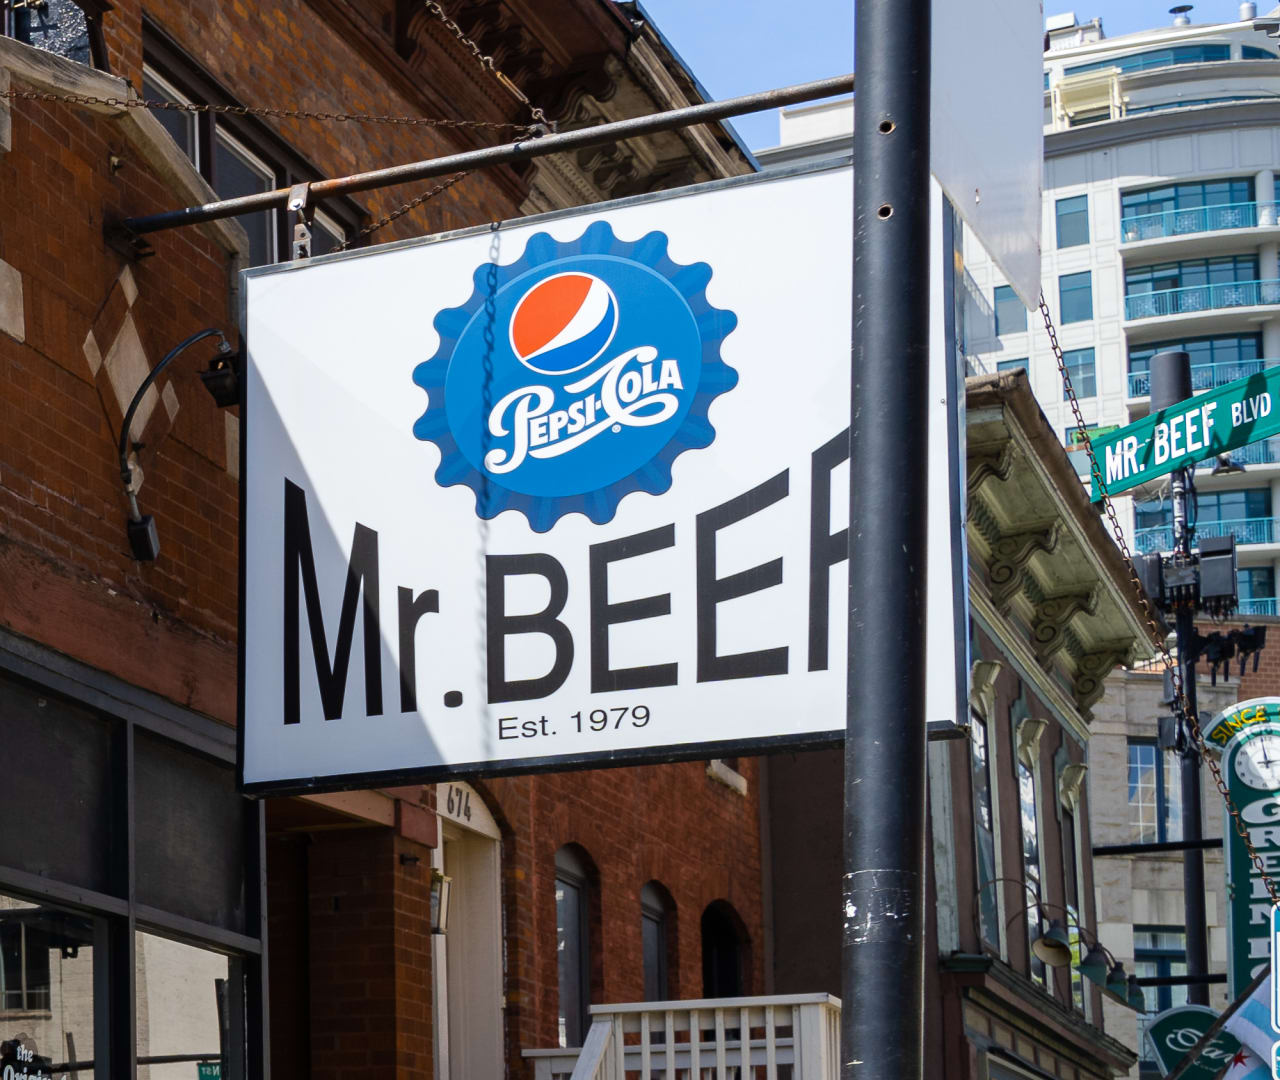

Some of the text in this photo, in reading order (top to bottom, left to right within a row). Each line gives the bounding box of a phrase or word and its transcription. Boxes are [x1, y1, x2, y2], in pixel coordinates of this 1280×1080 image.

[1105, 393, 1271, 485] MR. BEEF BLVD
[284, 477, 464, 725] Mr.
[498, 705, 651, 740] Est. 1979
[1211, 705, 1266, 744] SINCE
[447, 784, 471, 822] 674
[16, 1043, 34, 1062] the
